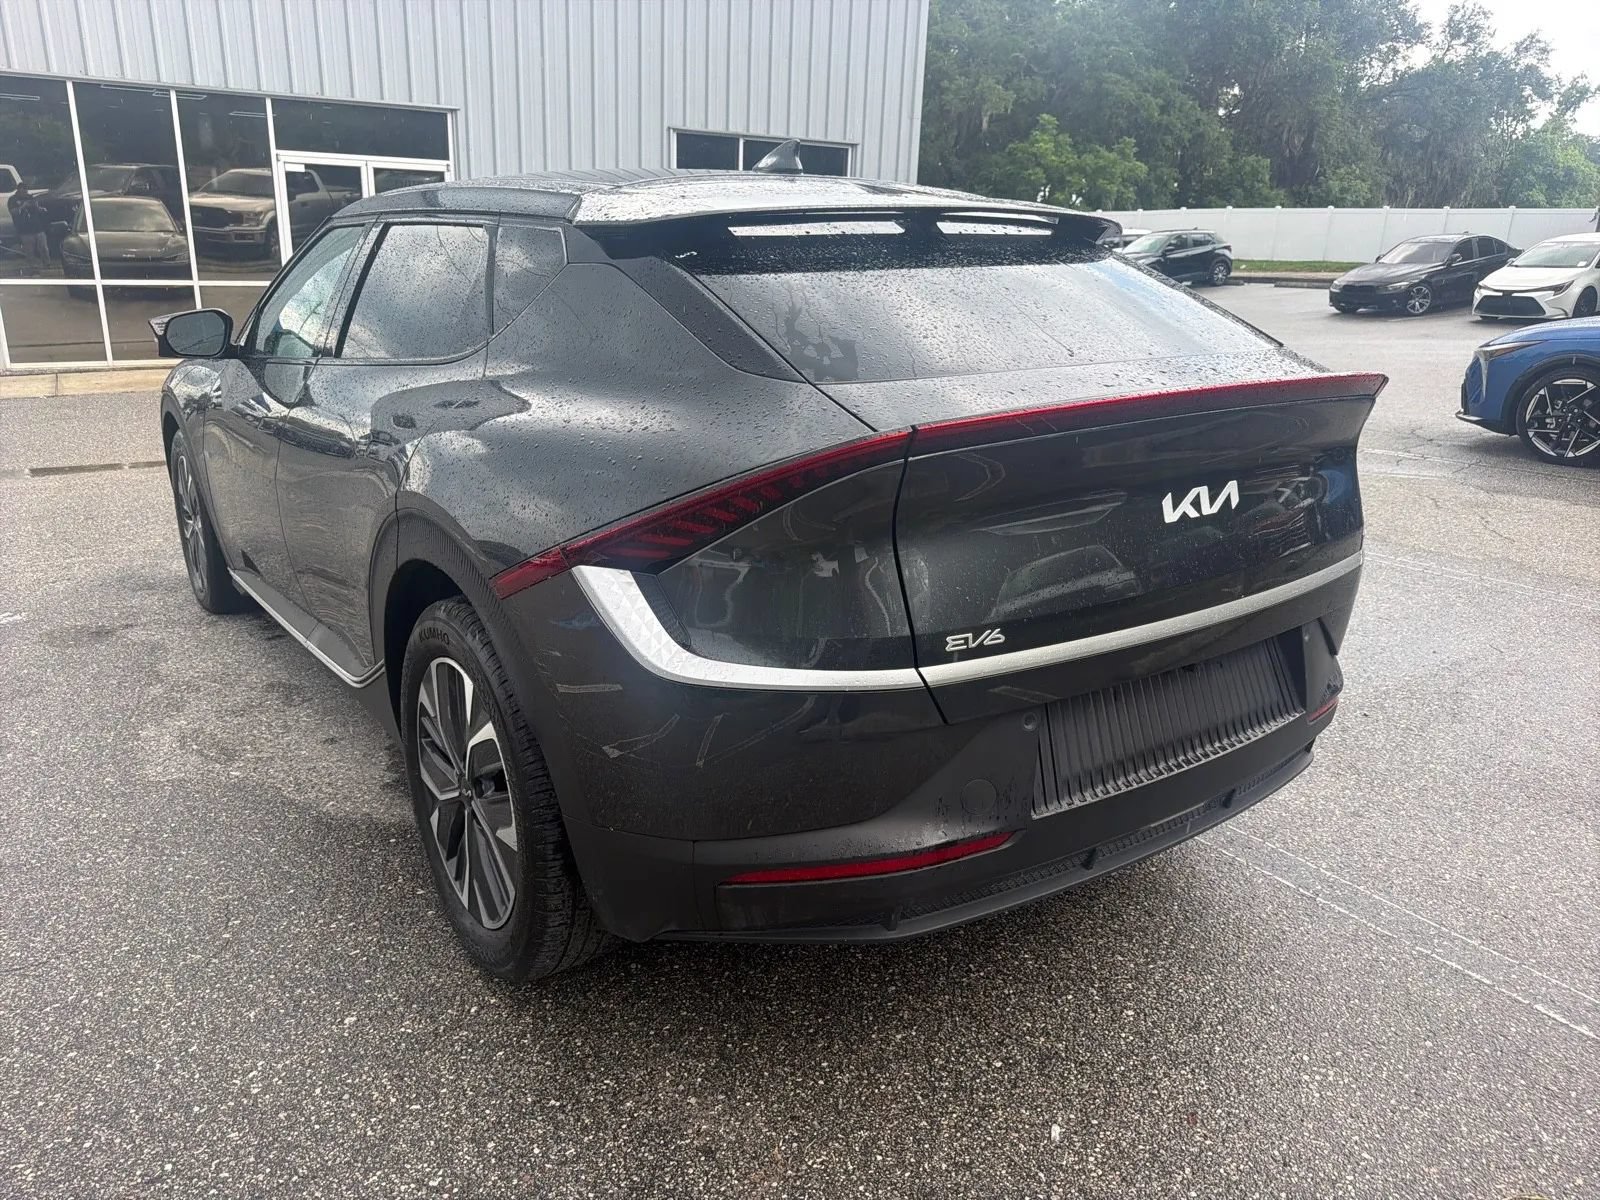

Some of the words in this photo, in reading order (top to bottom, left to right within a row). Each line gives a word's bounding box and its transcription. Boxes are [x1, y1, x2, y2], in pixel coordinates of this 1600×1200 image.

[1162, 480, 1239, 523] KIA
[419, 626, 449, 645] KUMHO
[945, 628, 1005, 651] EV6
